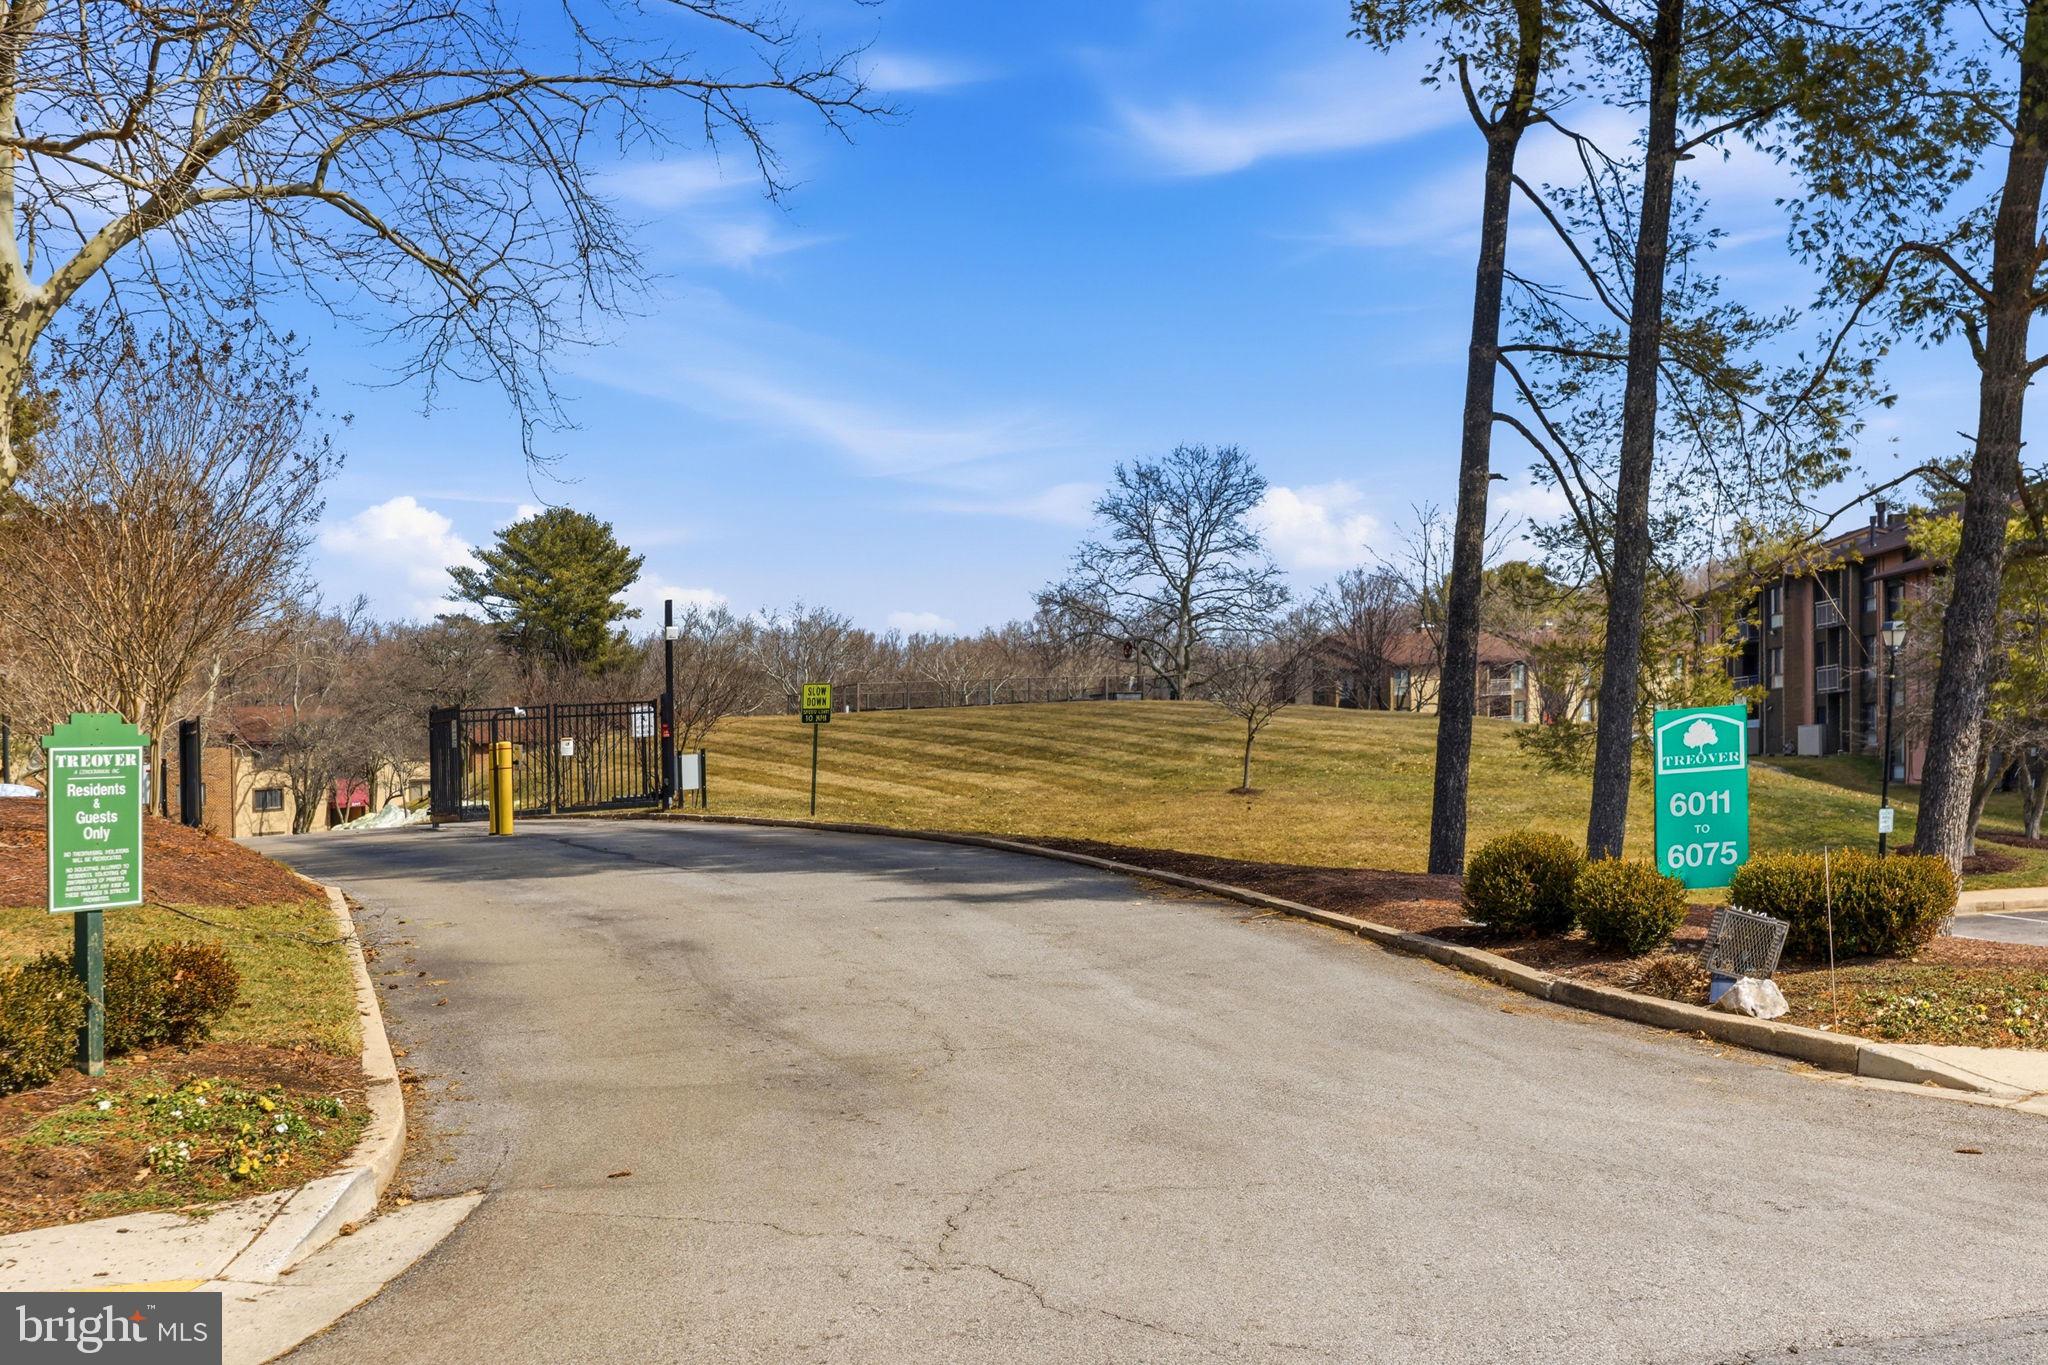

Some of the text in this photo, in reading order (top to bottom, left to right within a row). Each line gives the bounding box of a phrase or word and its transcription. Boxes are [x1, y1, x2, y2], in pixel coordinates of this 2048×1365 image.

[808, 687, 826, 696] SLOW
[807, 698, 826, 706] DOWN
[55, 754, 137, 768] TREOVER
[1663, 752, 1740, 766] TREOVER
[67, 783, 126, 797] Residents
[93, 798, 101, 809] &
[1670, 790, 1730, 817] 6011
[76, 811, 118, 824] Guests
[83, 826, 111, 842] Only
[1694, 824, 1710, 834] TO
[1667, 841, 1738, 869] 6075
